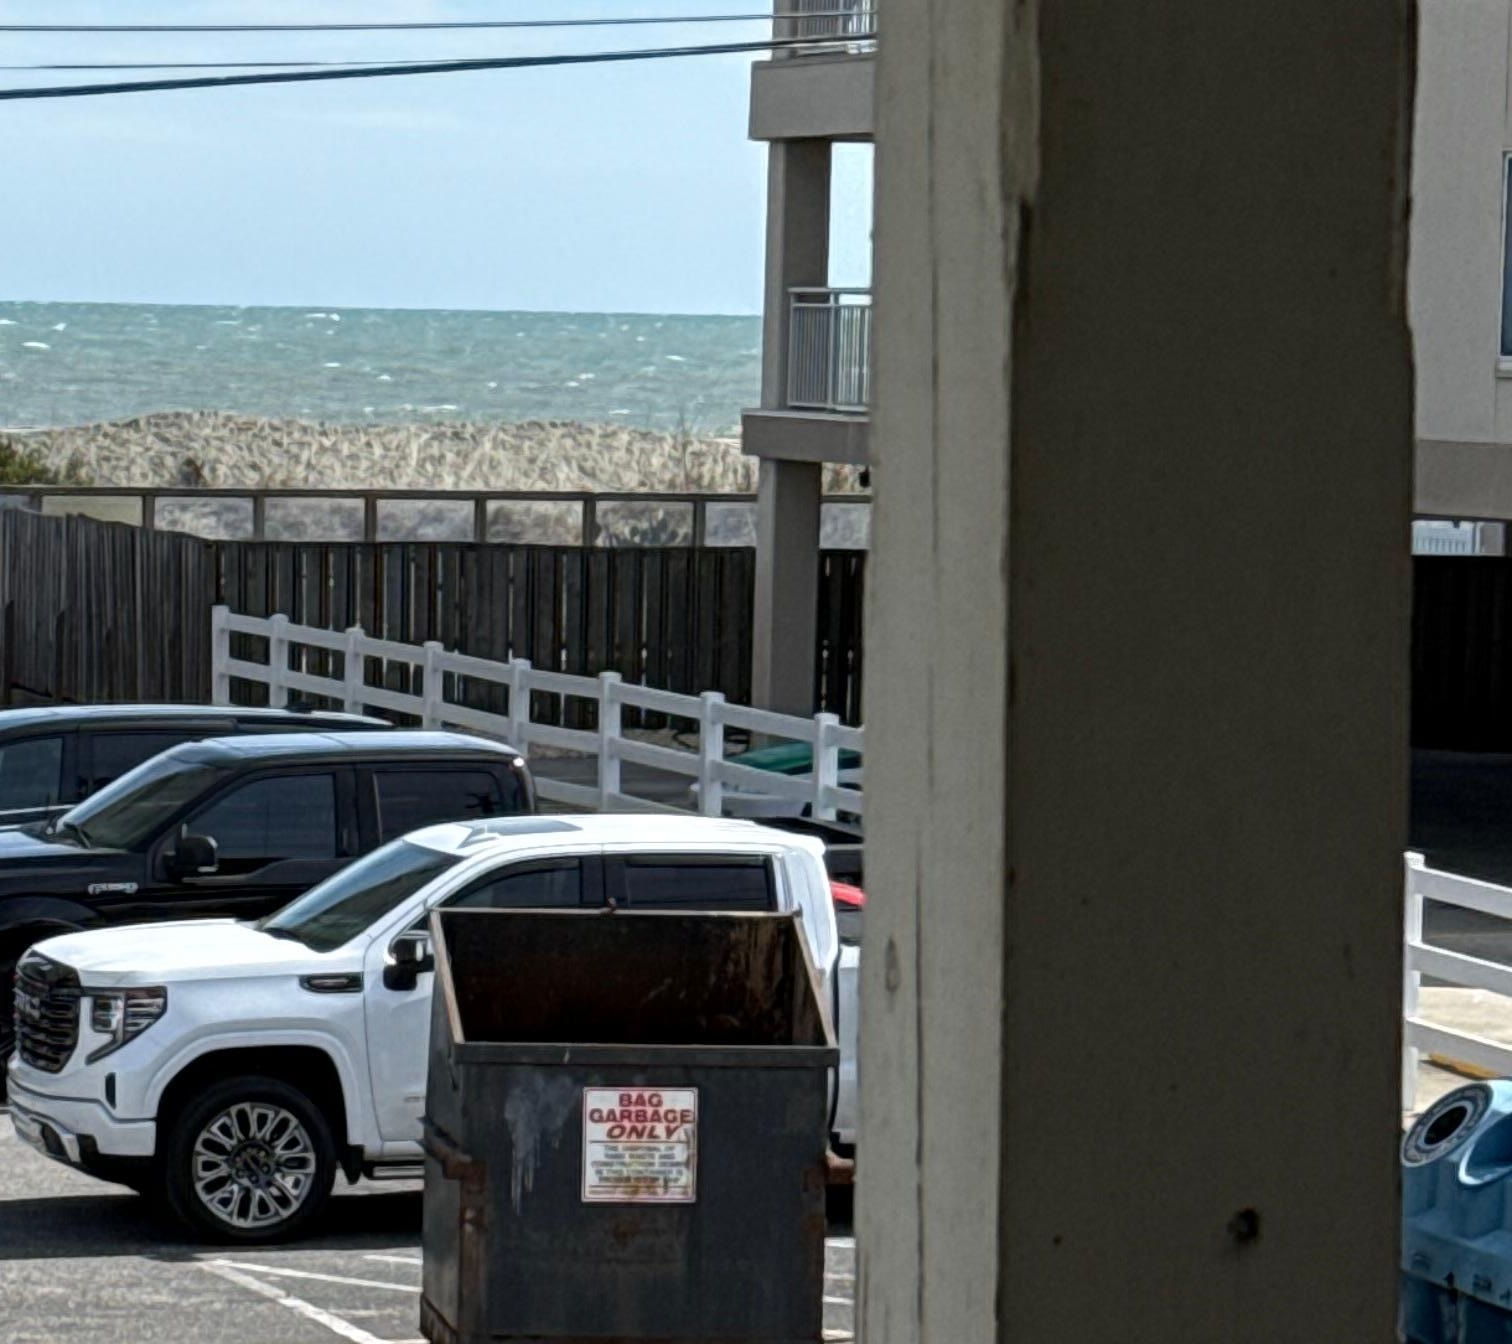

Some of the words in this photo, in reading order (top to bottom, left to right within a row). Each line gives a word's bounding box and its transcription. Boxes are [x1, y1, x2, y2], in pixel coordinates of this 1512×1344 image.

[619, 1093, 663, 1107] BAG
[589, 1108, 696, 1123] GARBAGE
[606, 1124, 680, 1139] ONLY
